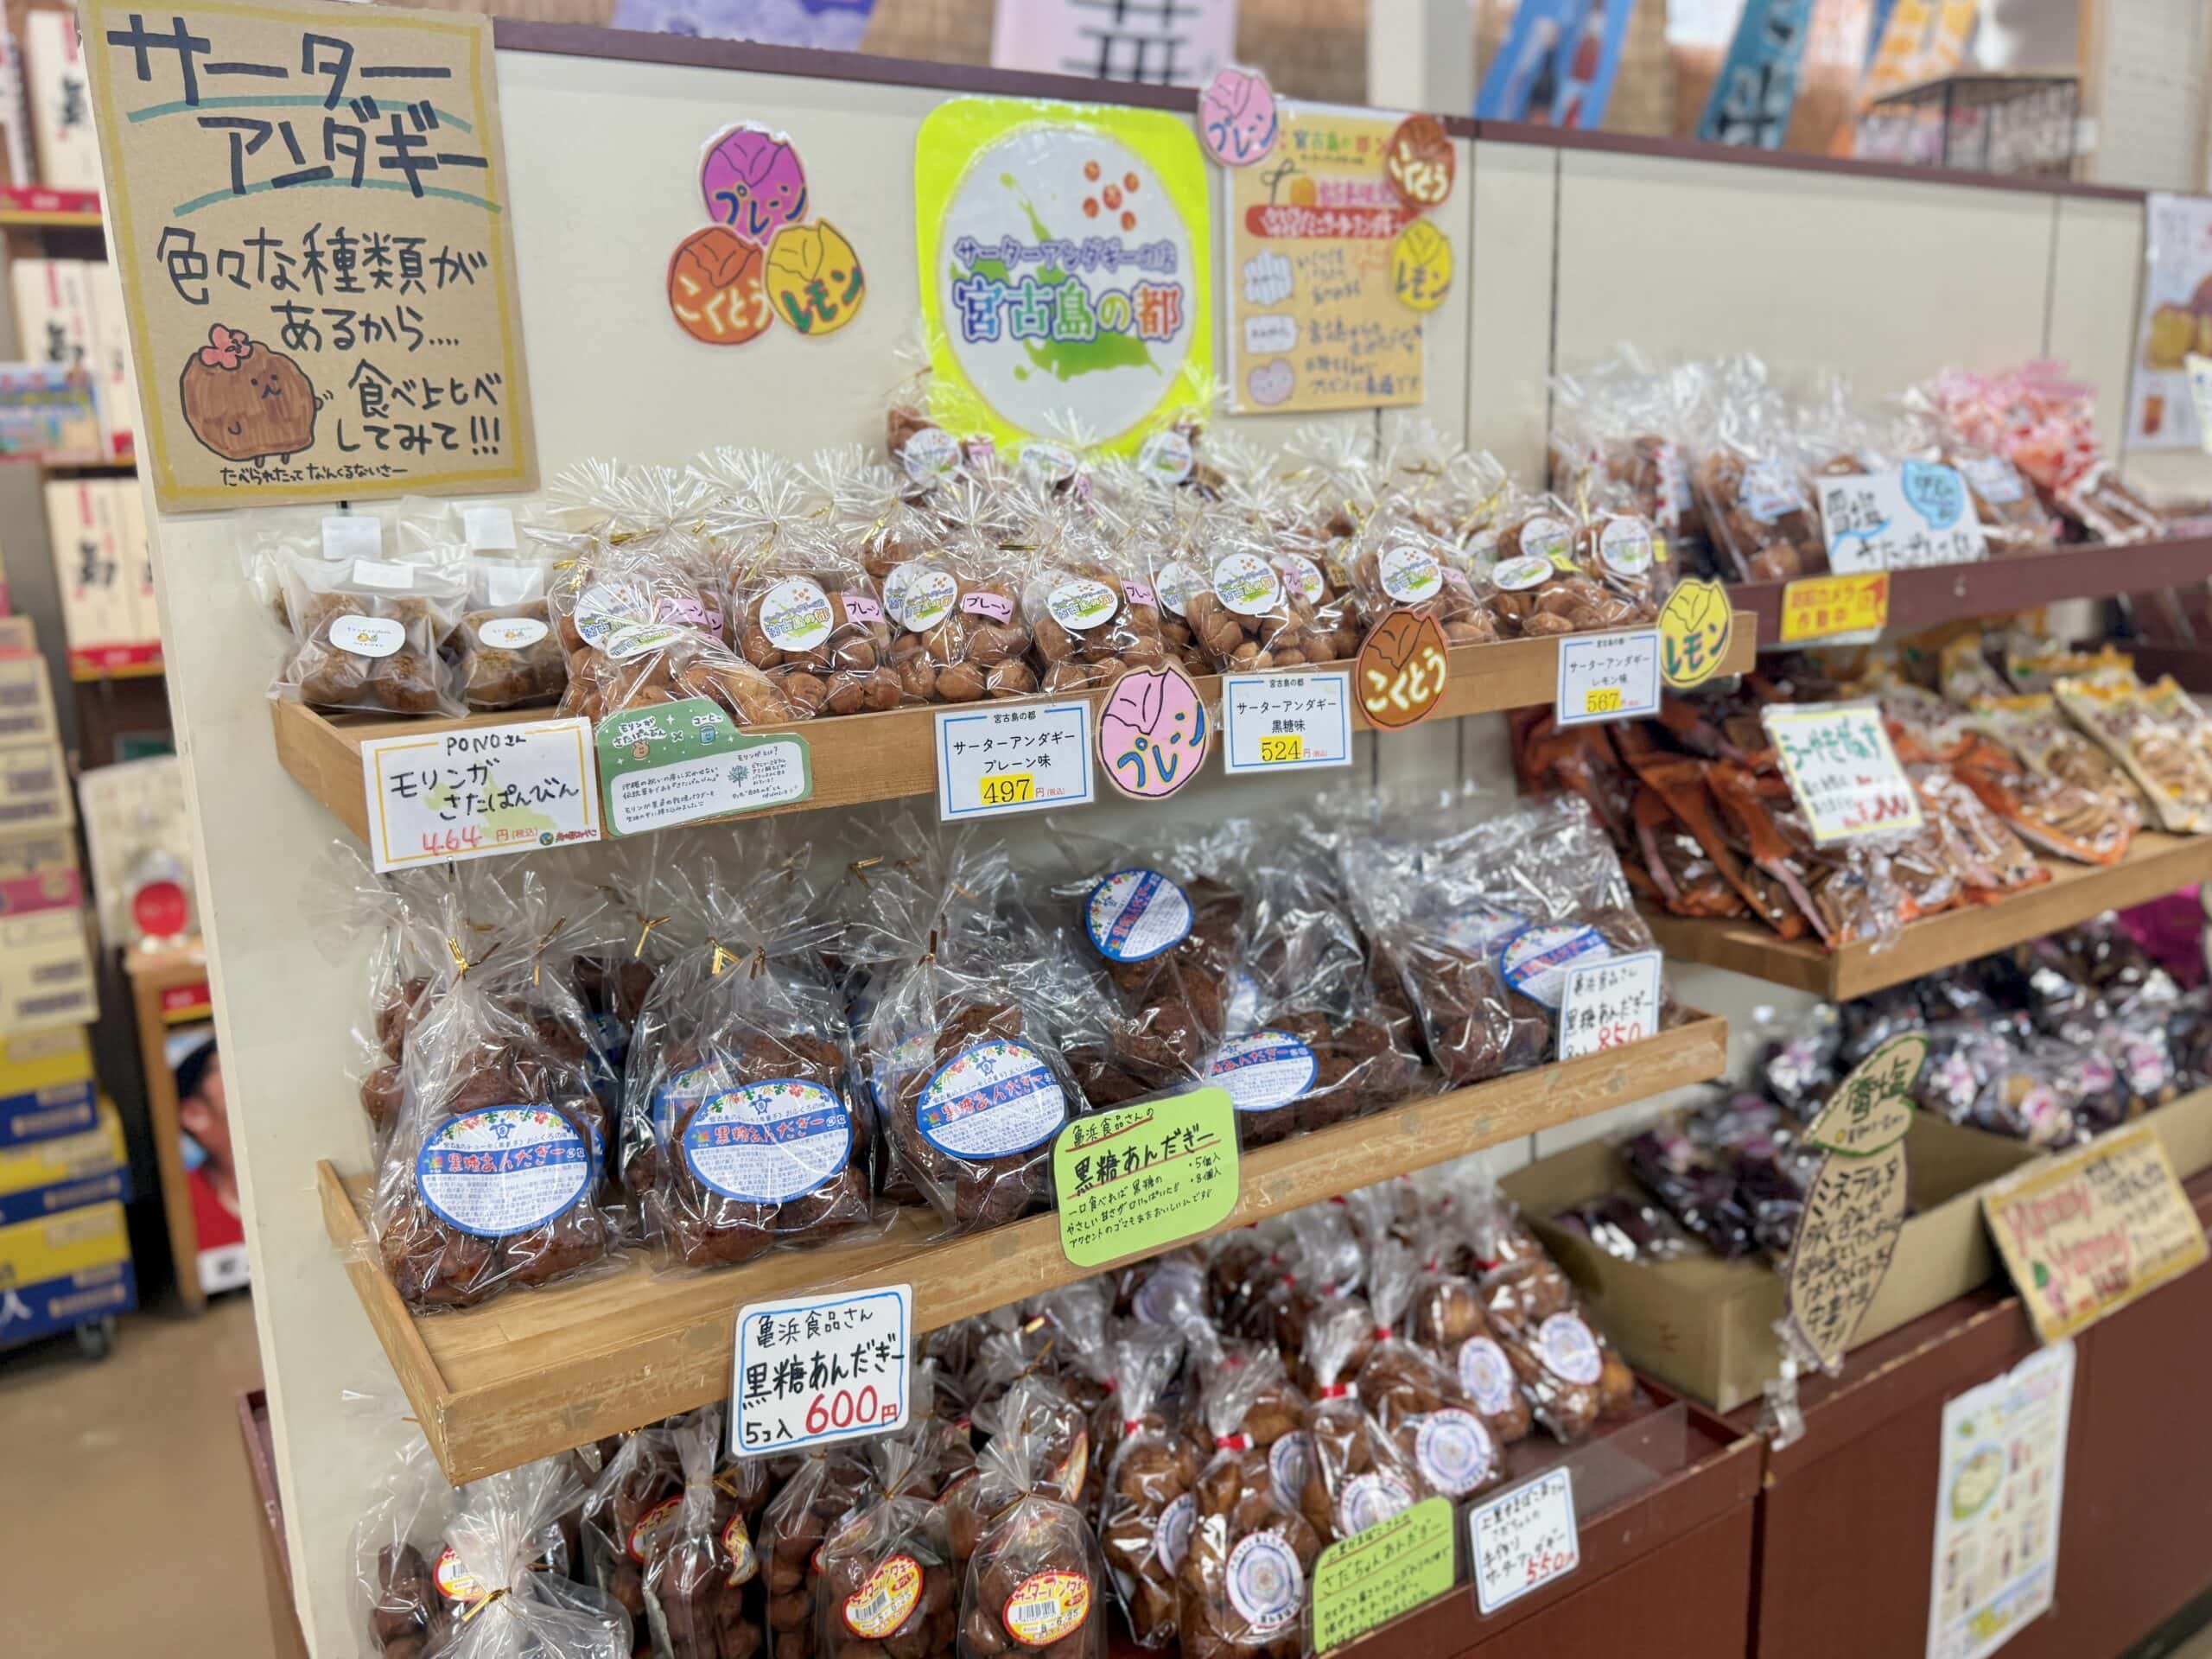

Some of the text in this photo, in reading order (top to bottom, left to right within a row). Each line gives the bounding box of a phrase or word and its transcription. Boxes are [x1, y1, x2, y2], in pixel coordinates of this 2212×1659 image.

[107, 14, 451, 110] サーター
[198, 96, 487, 198] アンダギー
[157, 223, 486, 305] 色々な種類が
[677, 276, 768, 334] こくとう
[781, 267, 862, 334] レモン
[952, 272, 1183, 343] 宮古島の都
[348, 359, 502, 418] 食べ比べ
[966, 596, 1011, 616] プレーン
[1666, 622, 1728, 675] レモン
[1269, 678, 1305, 688] 宮古島の都
[1365, 647, 1446, 711] こくとう
[994, 711, 1036, 724] 宮古島の都
[1237, 698, 1337, 715] サーターアンダギー
[953, 733, 1076, 754] サーターアンダギー
[1272, 719, 1306, 734] 黒糖味
[983, 754, 1052, 773] プレーン味
[1261, 741, 1300, 761] 524
[390, 757, 501, 798] モリンガ
[983, 779, 1030, 804] 497
[439, 780, 579, 821] さたぱんびん
[423, 824, 483, 856] 464
[715, 1116, 824, 1145] 黒糖あんだぎー
[1072, 1108, 1154, 1147] 亀浜食品さんの
[448, 1145, 565, 1173] 黒糖あんだぎー
[1074, 1123, 1215, 1197] 黒糖あんだぎー
[757, 1308, 873, 1348] 亀浜食品さん
[743, 1333, 905, 1409] 黒糖あんだぎー
[747, 1419, 792, 1444] 5コ入
